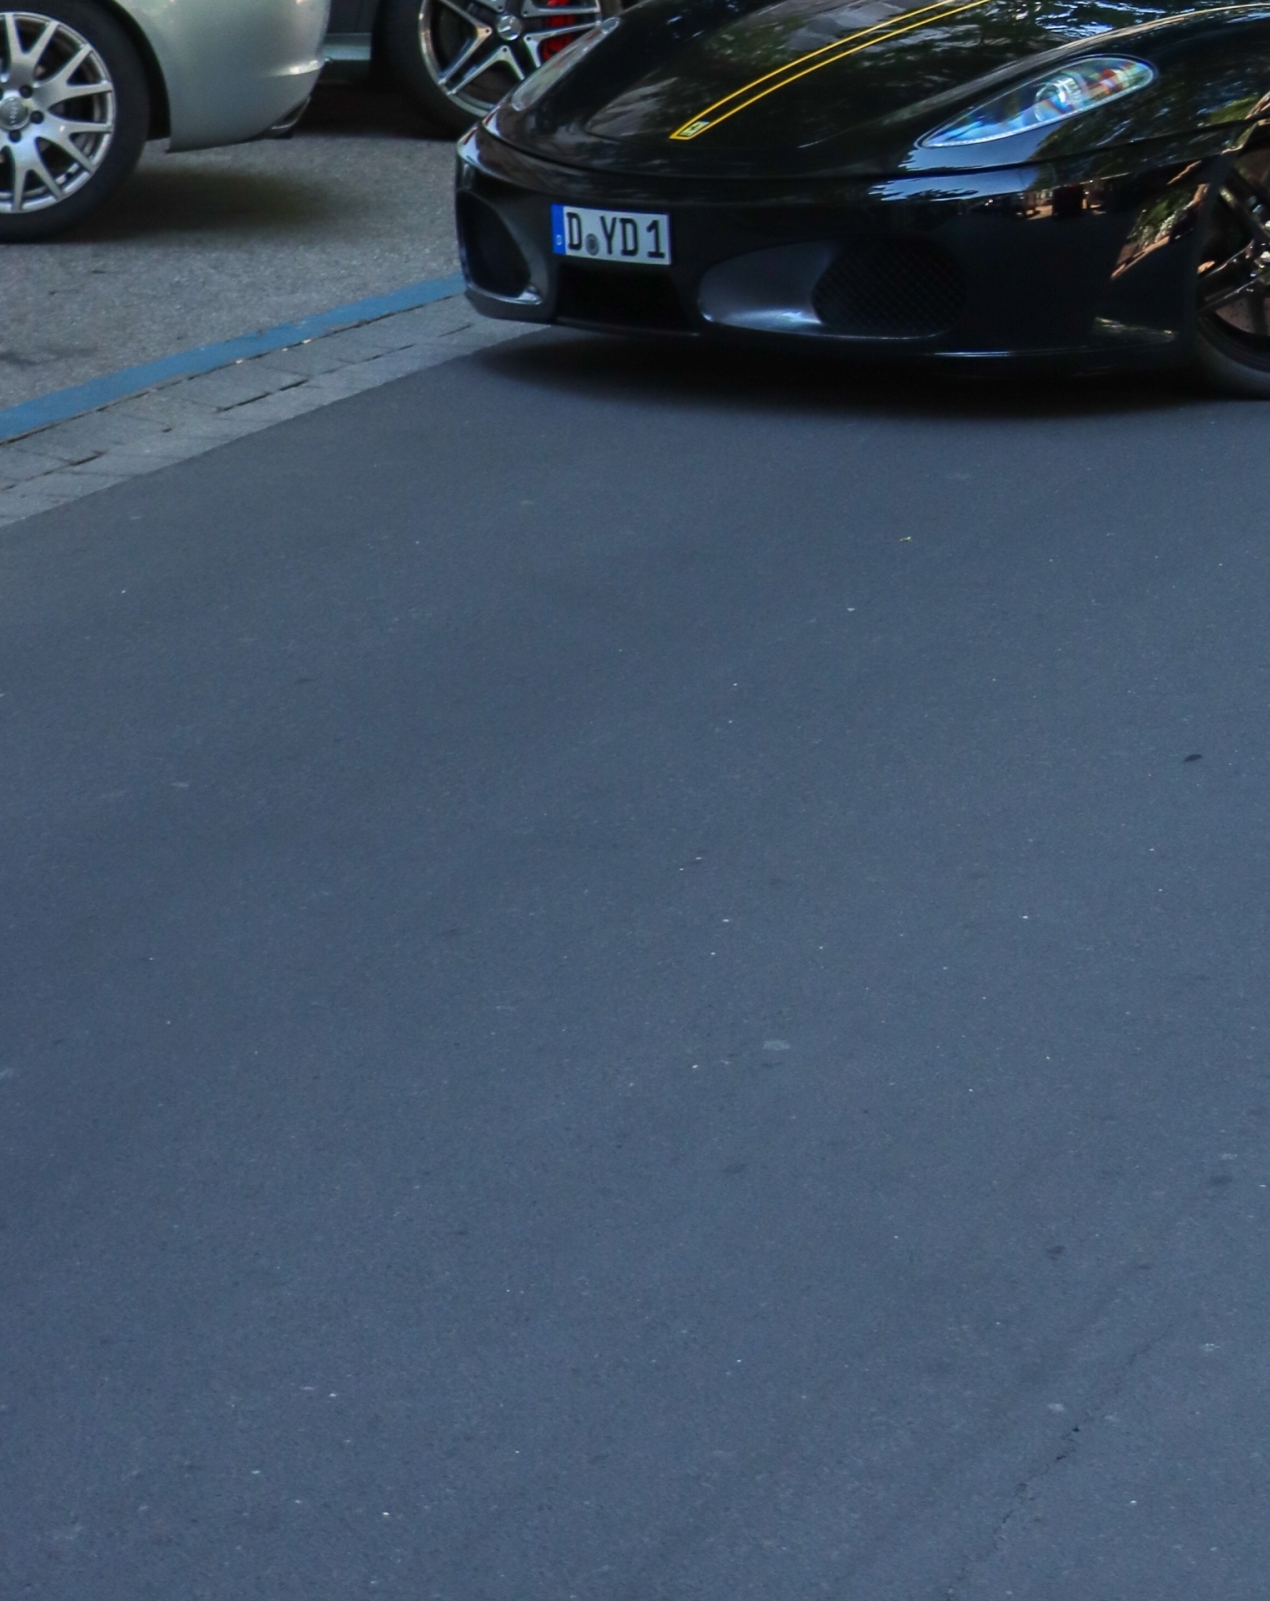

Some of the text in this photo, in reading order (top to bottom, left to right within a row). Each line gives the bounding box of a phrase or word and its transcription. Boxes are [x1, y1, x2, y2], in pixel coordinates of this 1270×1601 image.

[566, 212, 666, 259] D YD 1
